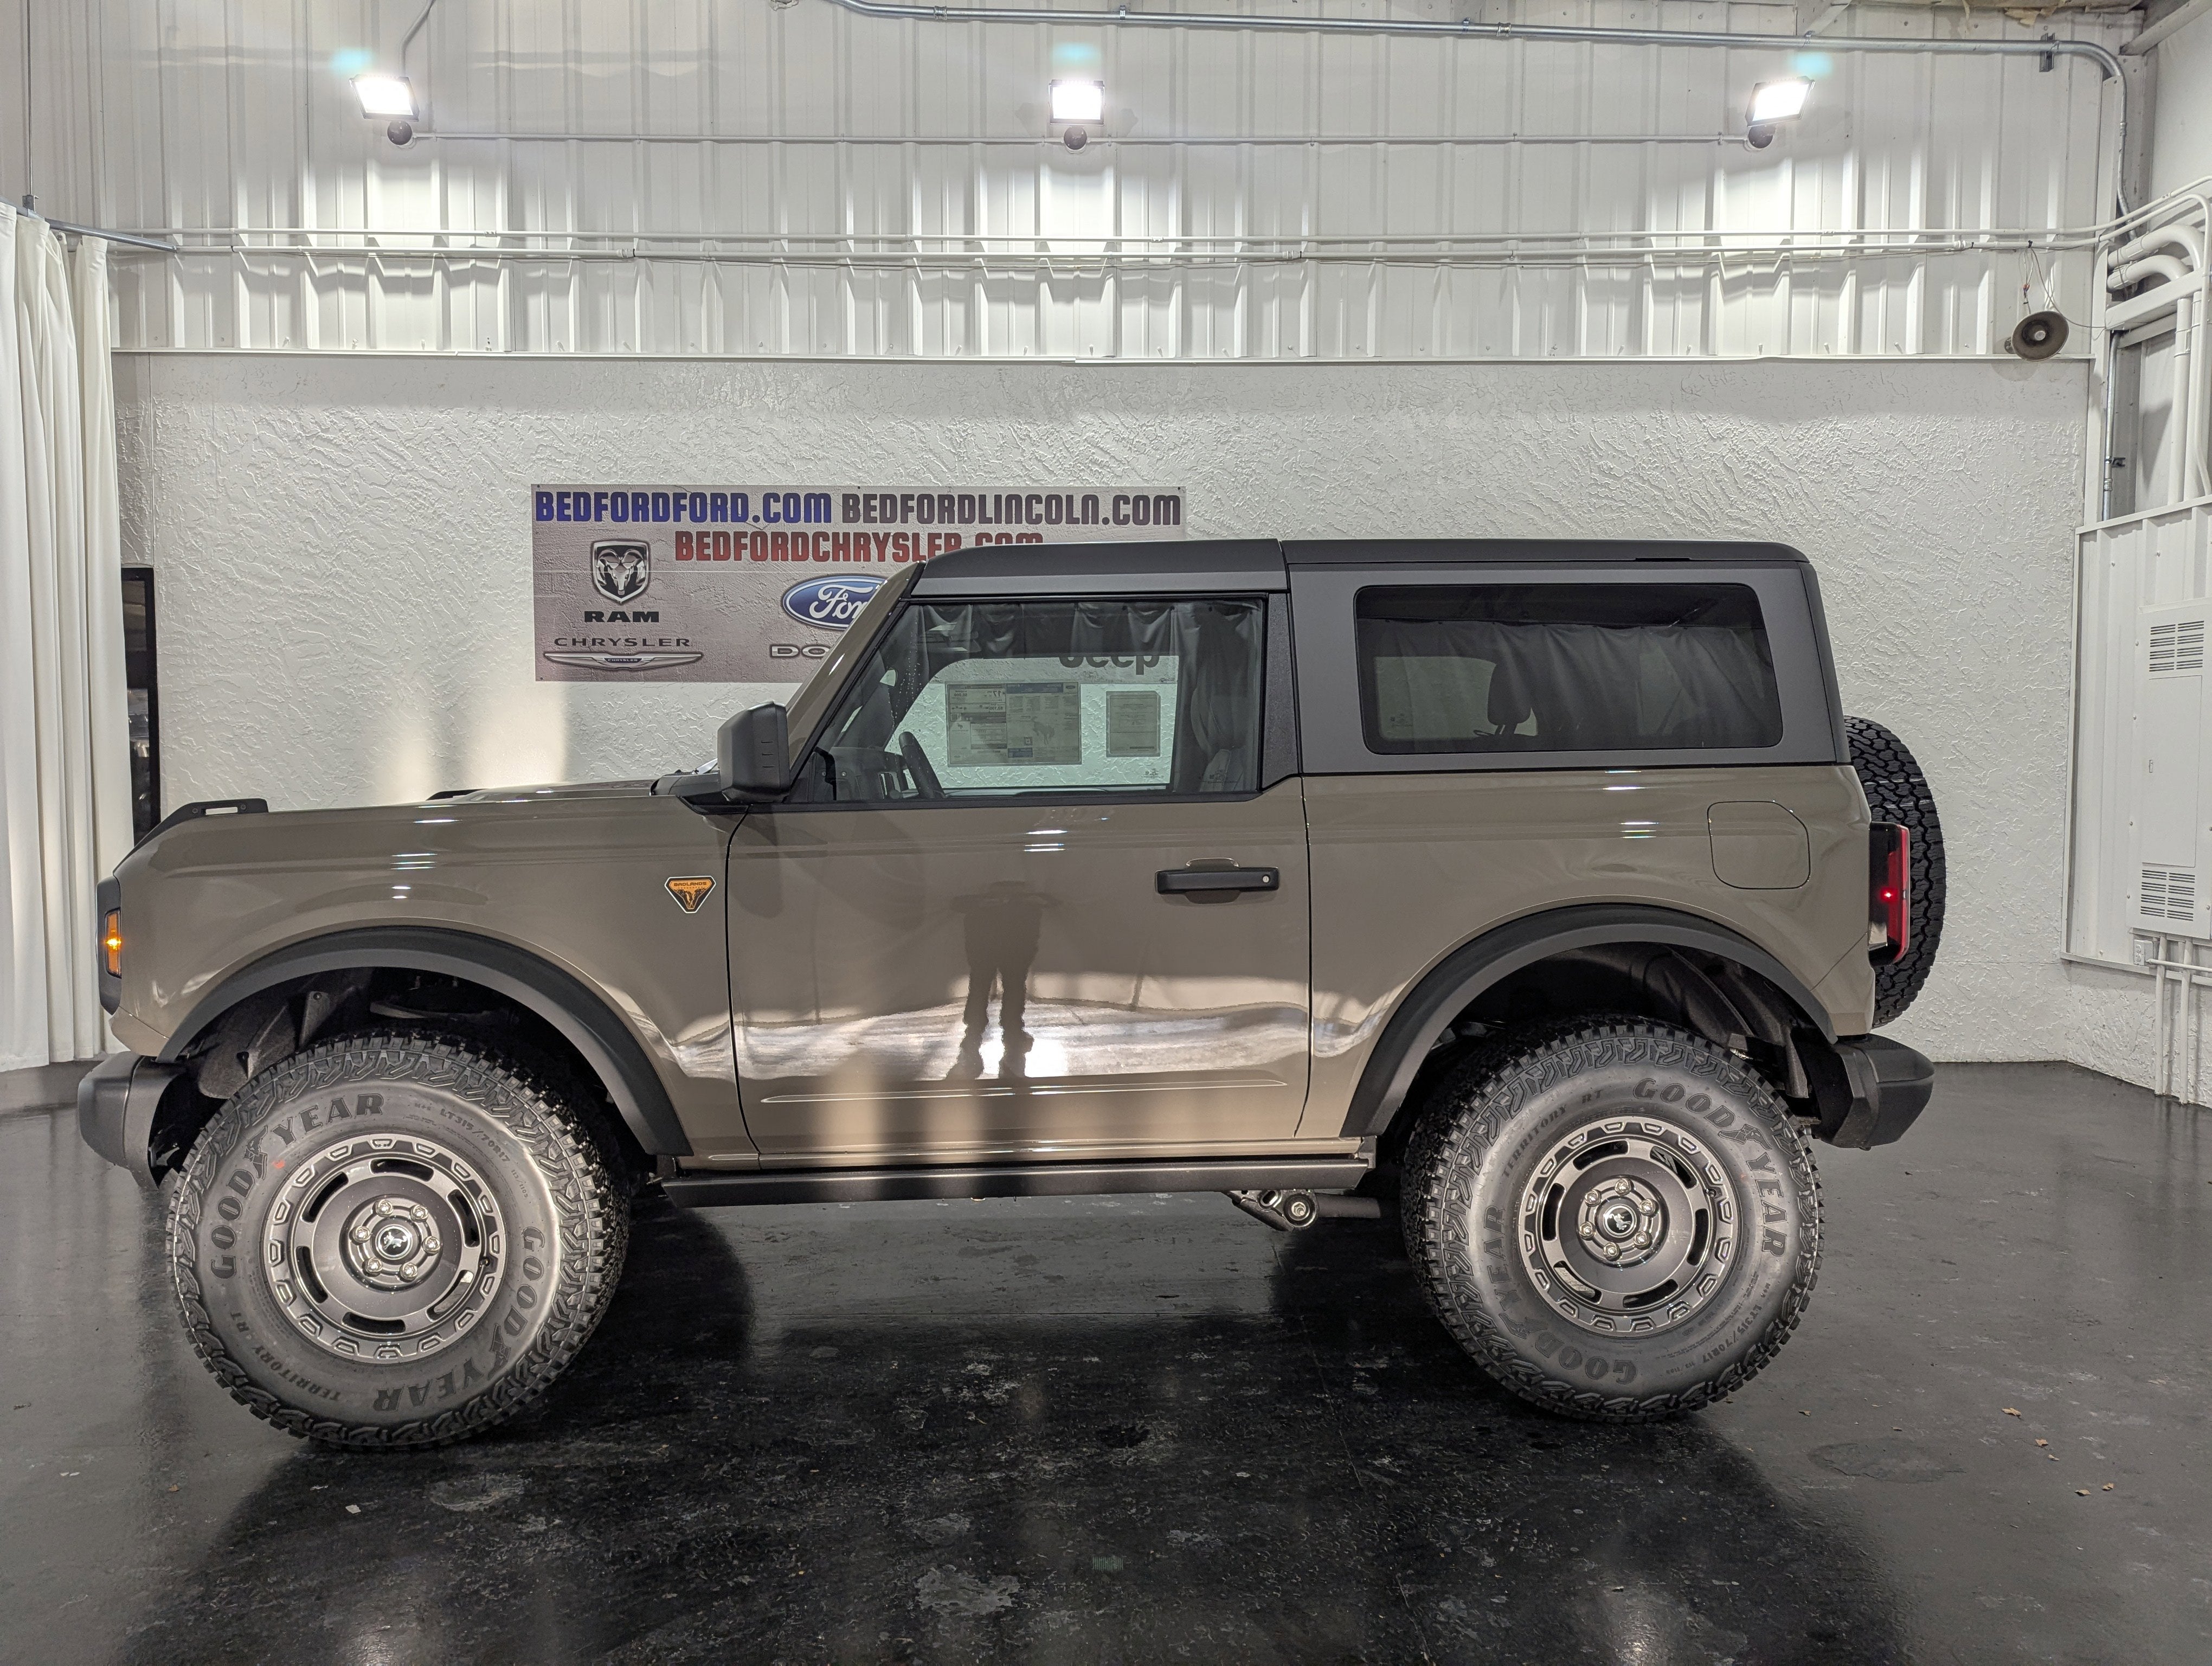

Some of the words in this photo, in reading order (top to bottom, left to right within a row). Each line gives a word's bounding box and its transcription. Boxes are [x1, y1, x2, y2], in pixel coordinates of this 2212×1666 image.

[535, 491, 832, 524] BEDFORDFORD.COM
[842, 493, 1181, 526] BEDFORDLINCOLN.COM
[584, 611, 659, 623] RAM
[809, 584, 873, 619] For
[554, 637, 691, 648] CHRYSLER
[440, 1108, 511, 1162] LT315/70R17
